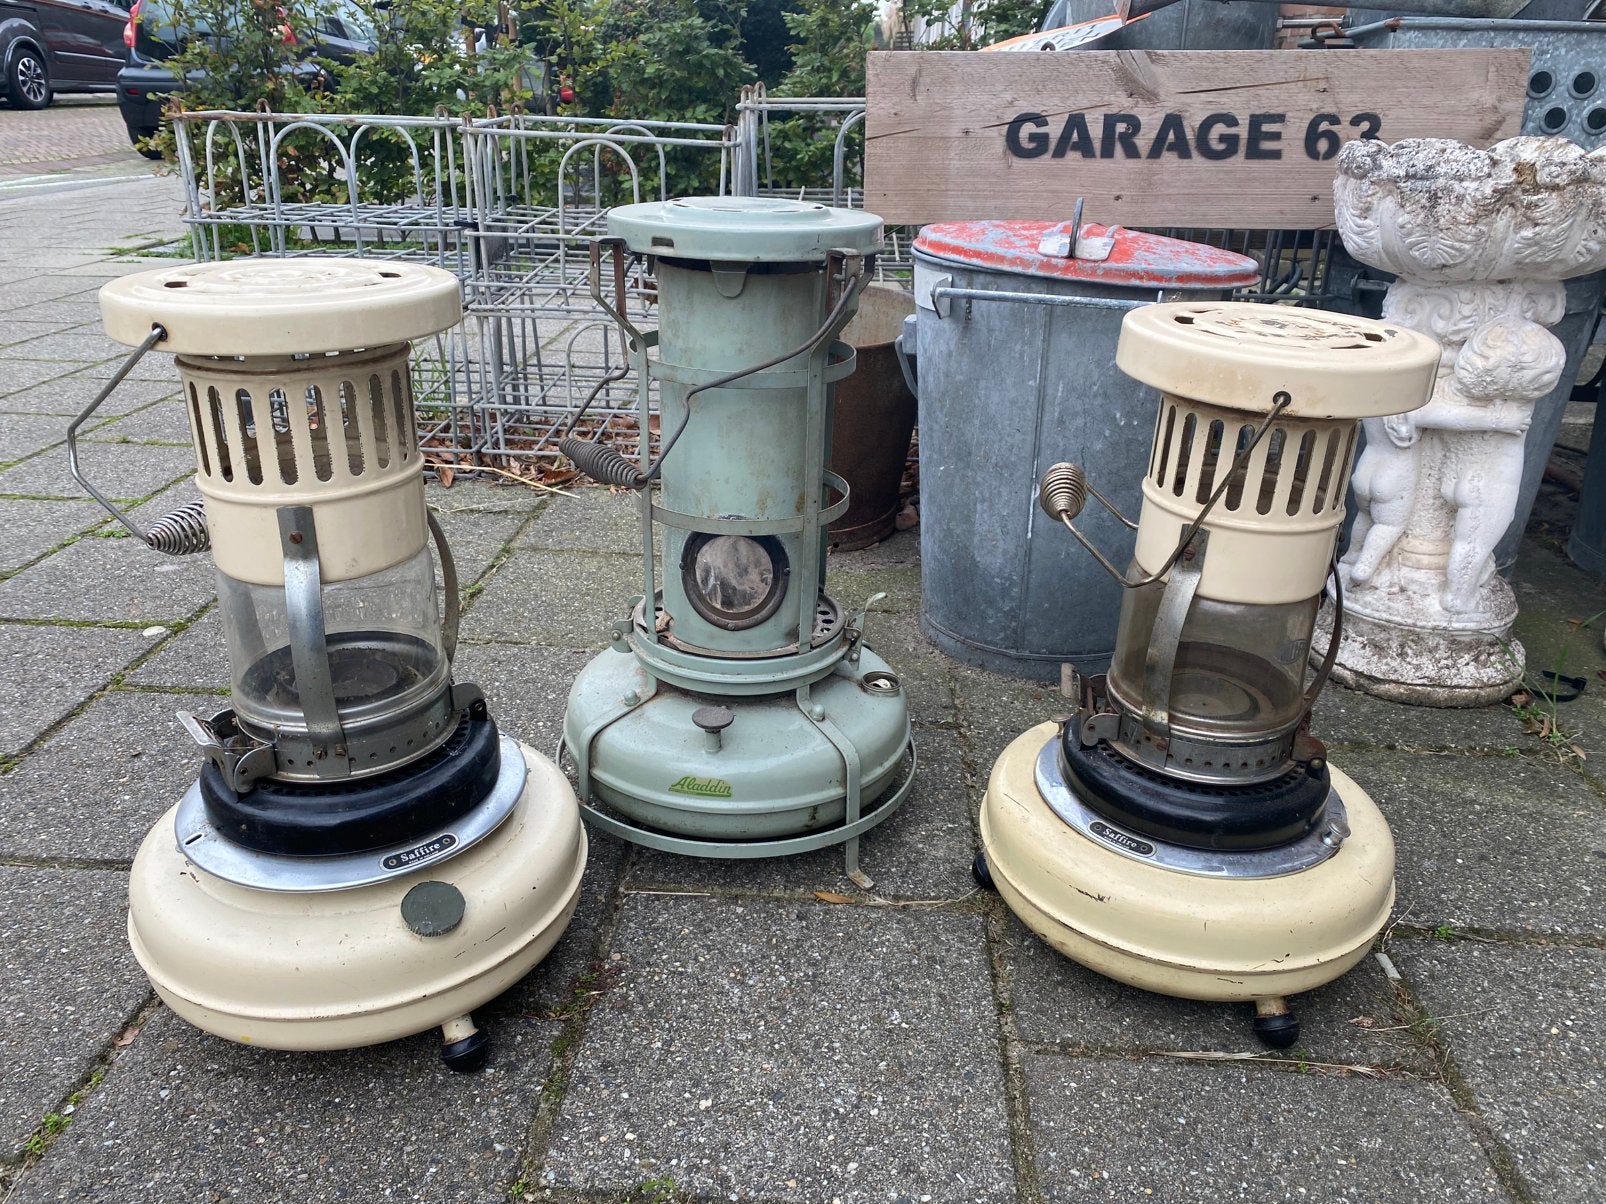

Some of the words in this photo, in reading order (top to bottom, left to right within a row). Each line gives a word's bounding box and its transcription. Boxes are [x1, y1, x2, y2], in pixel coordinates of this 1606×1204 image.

[1006, 112, 1286, 160] GARAGE
[669, 776, 731, 795] Aladdin
[1103, 828, 1137, 848] Saffire
[400, 843, 441, 862] Saffire
